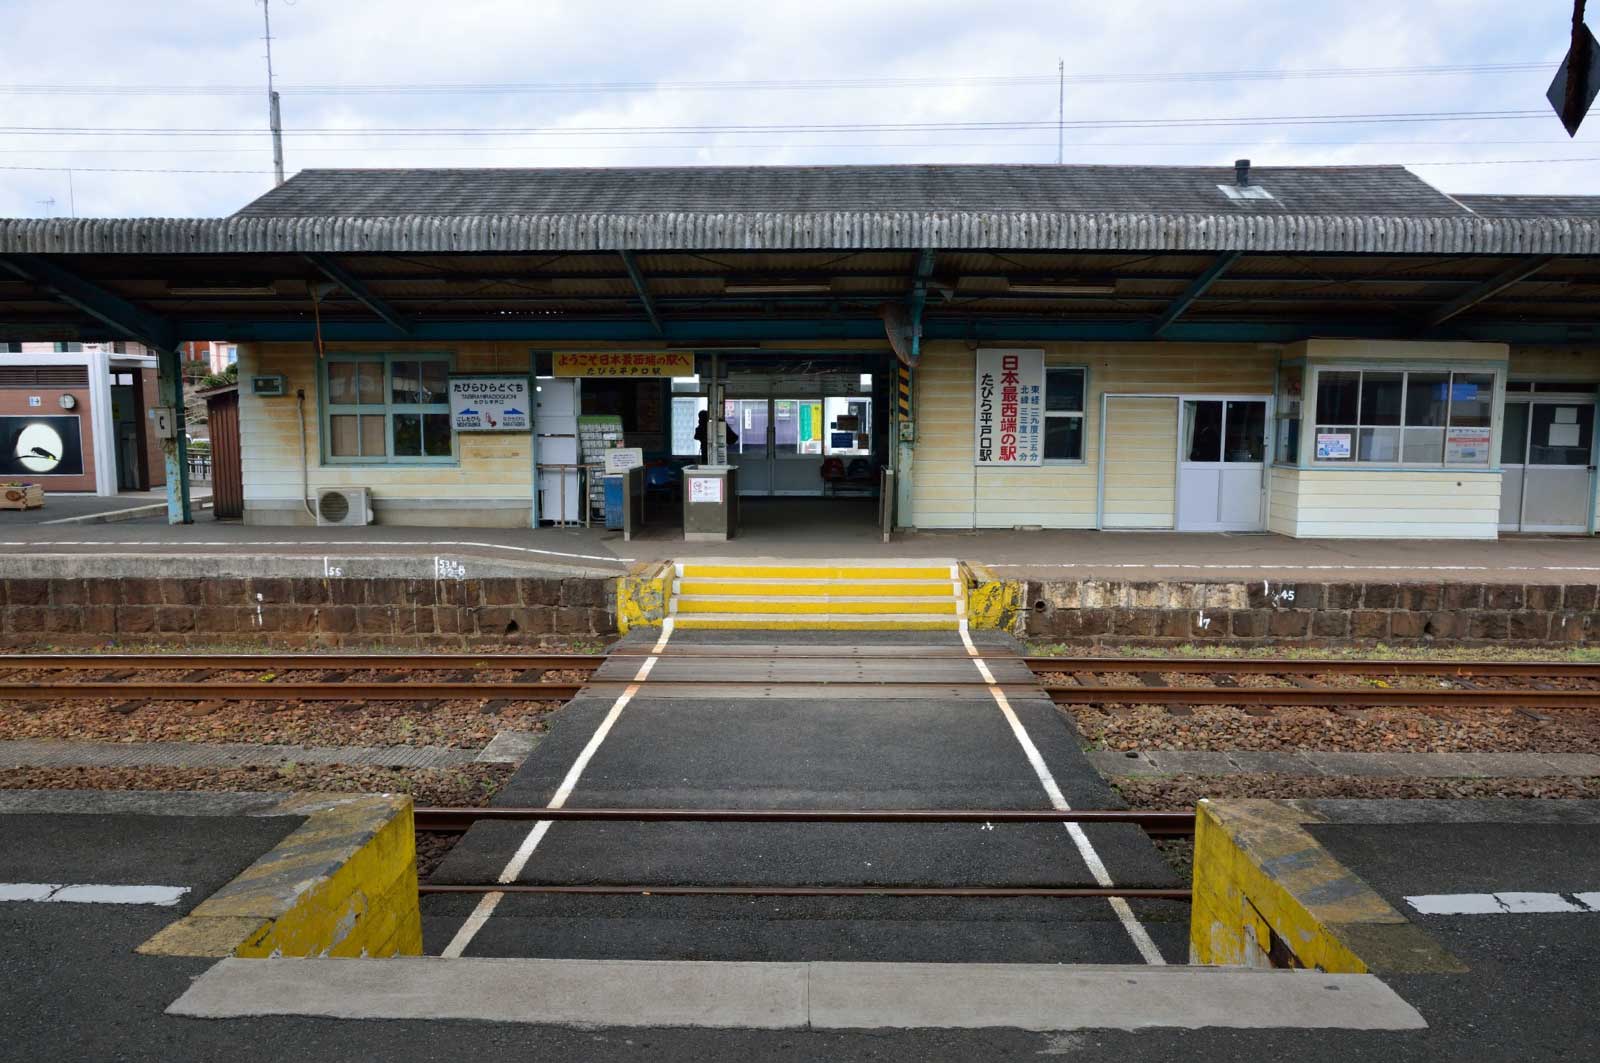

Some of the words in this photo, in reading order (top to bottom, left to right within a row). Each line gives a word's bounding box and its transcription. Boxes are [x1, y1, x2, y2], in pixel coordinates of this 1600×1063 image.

[454, 383, 523, 392] たびらひらどぐち
[999, 355, 1020, 462] 日本最西端の駅
[980, 373, 994, 462] たびら平戸口駅
[1280, 589, 1295, 601] 45
